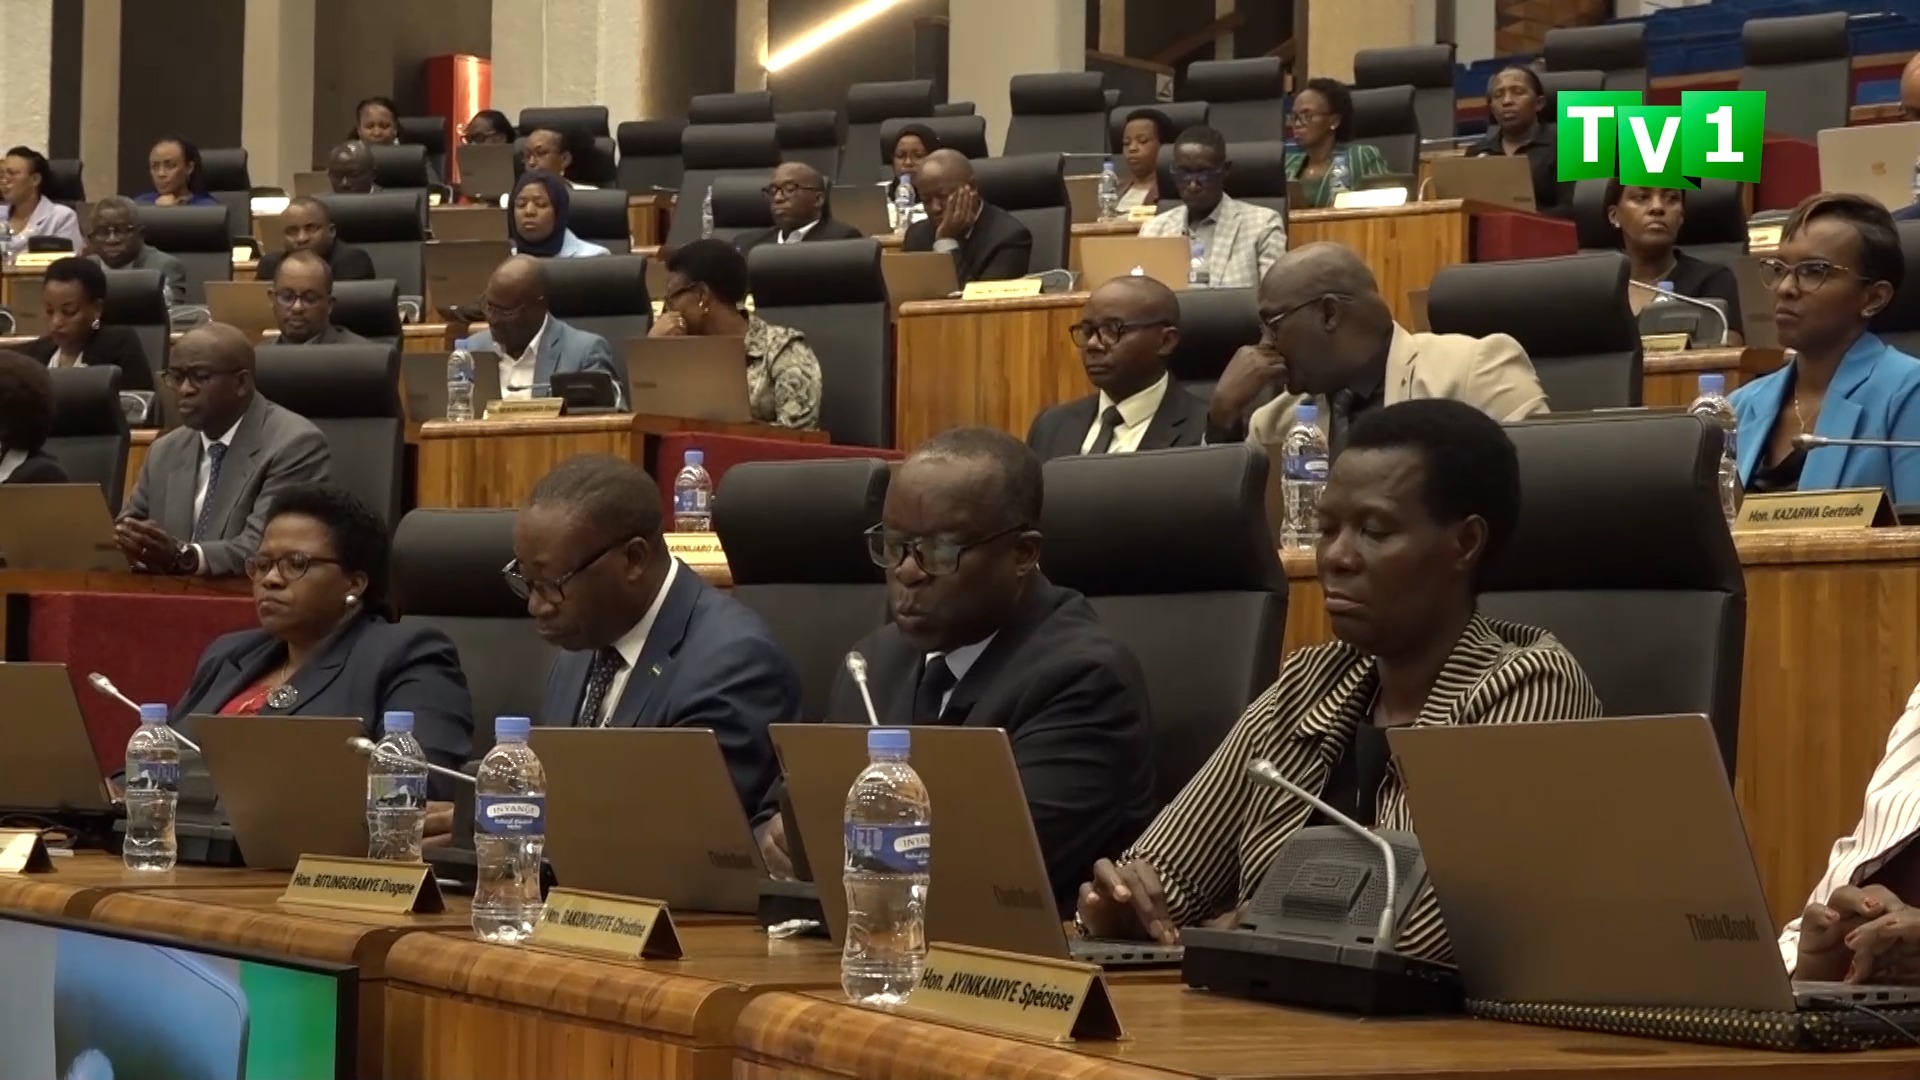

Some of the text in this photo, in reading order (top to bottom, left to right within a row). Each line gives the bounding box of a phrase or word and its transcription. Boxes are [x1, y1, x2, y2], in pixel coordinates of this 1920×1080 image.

[1748, 503, 1865, 522] Hon. KAZARWA Gertrude
[313, 873, 380, 892] BITUNGURAMYE
[380, 878, 416, 898] Diogene
[1684, 912, 1760, 942] ThinkBook
[918, 967, 1075, 1012] Hon. AYINKAMIYE Spéciose
